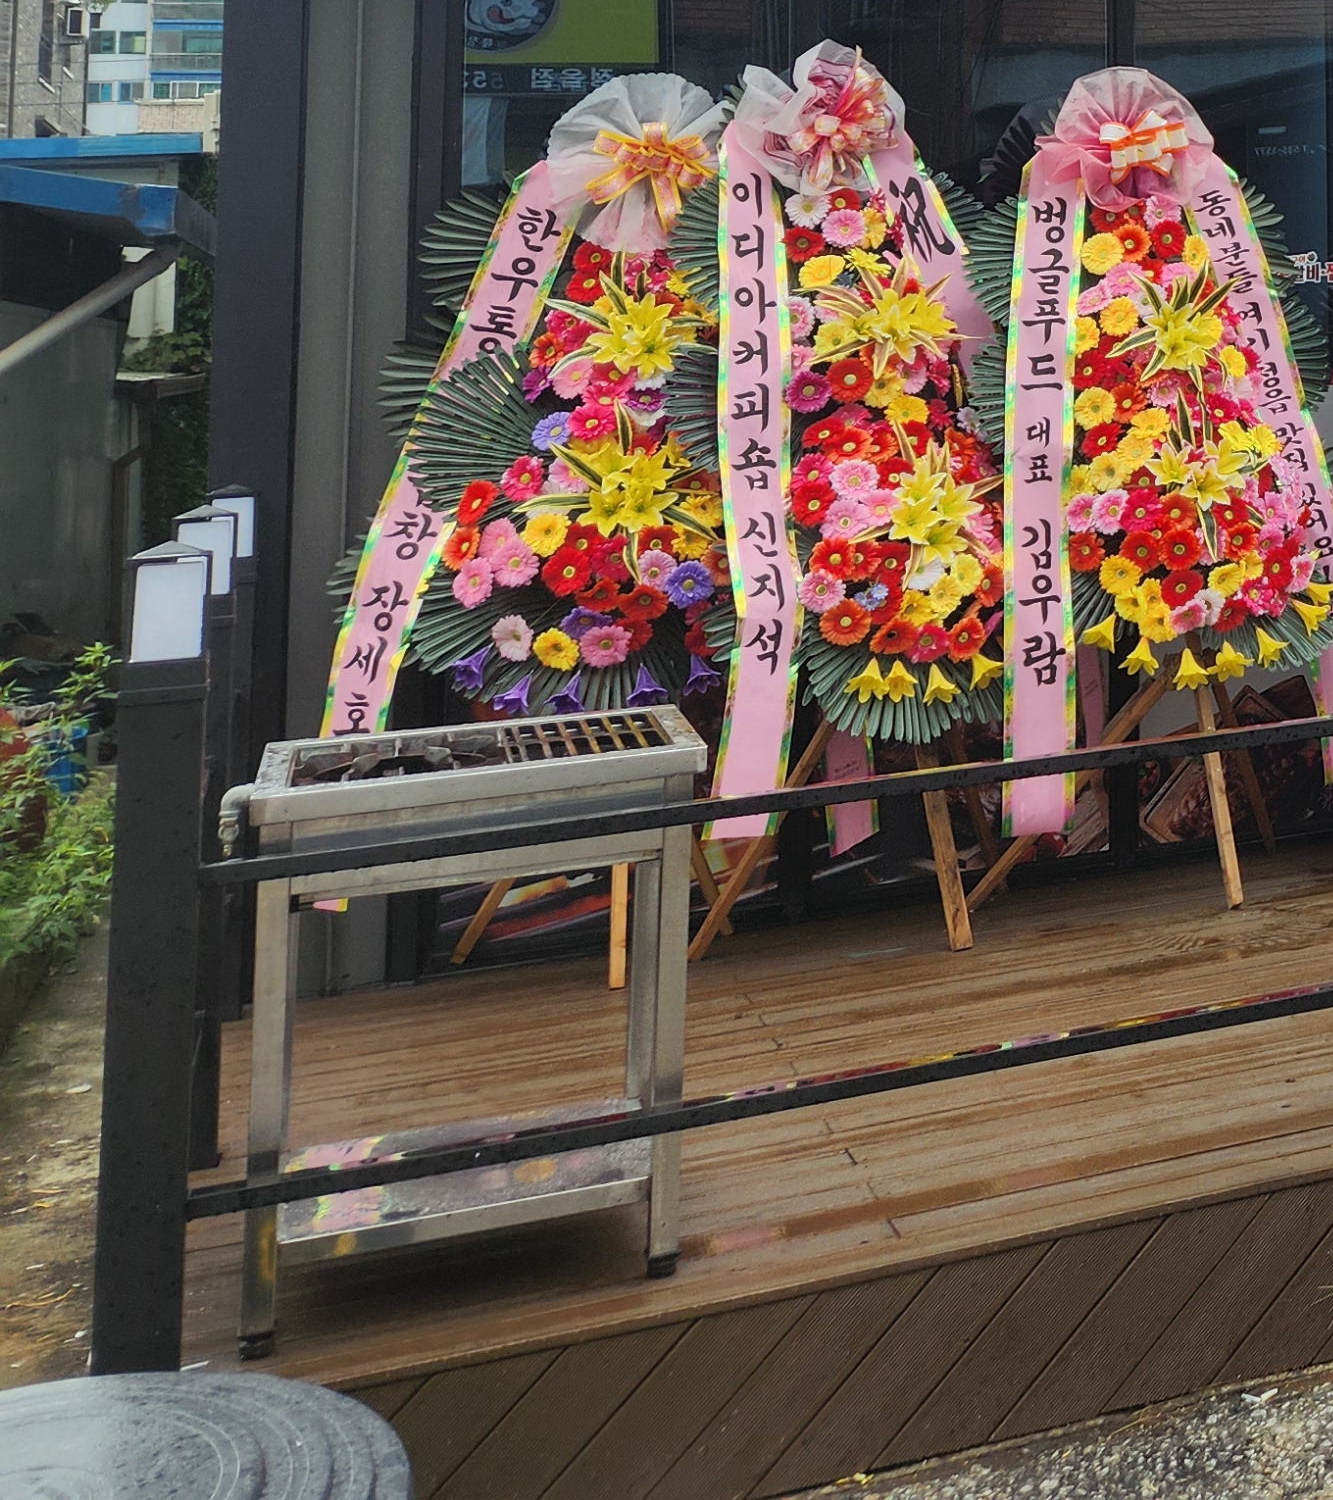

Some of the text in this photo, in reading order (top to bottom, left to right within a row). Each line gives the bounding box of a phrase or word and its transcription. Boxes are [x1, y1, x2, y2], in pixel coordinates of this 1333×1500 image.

[889, 178, 956, 263] 祝
[1194, 190, 1258, 294] 동네분들
[1237, 302, 1270, 351] 여기
[731, 172, 785, 675] 이디아커피숍 신지석
[1018, 196, 1070, 686] 벙글푸드 대표 김우람
